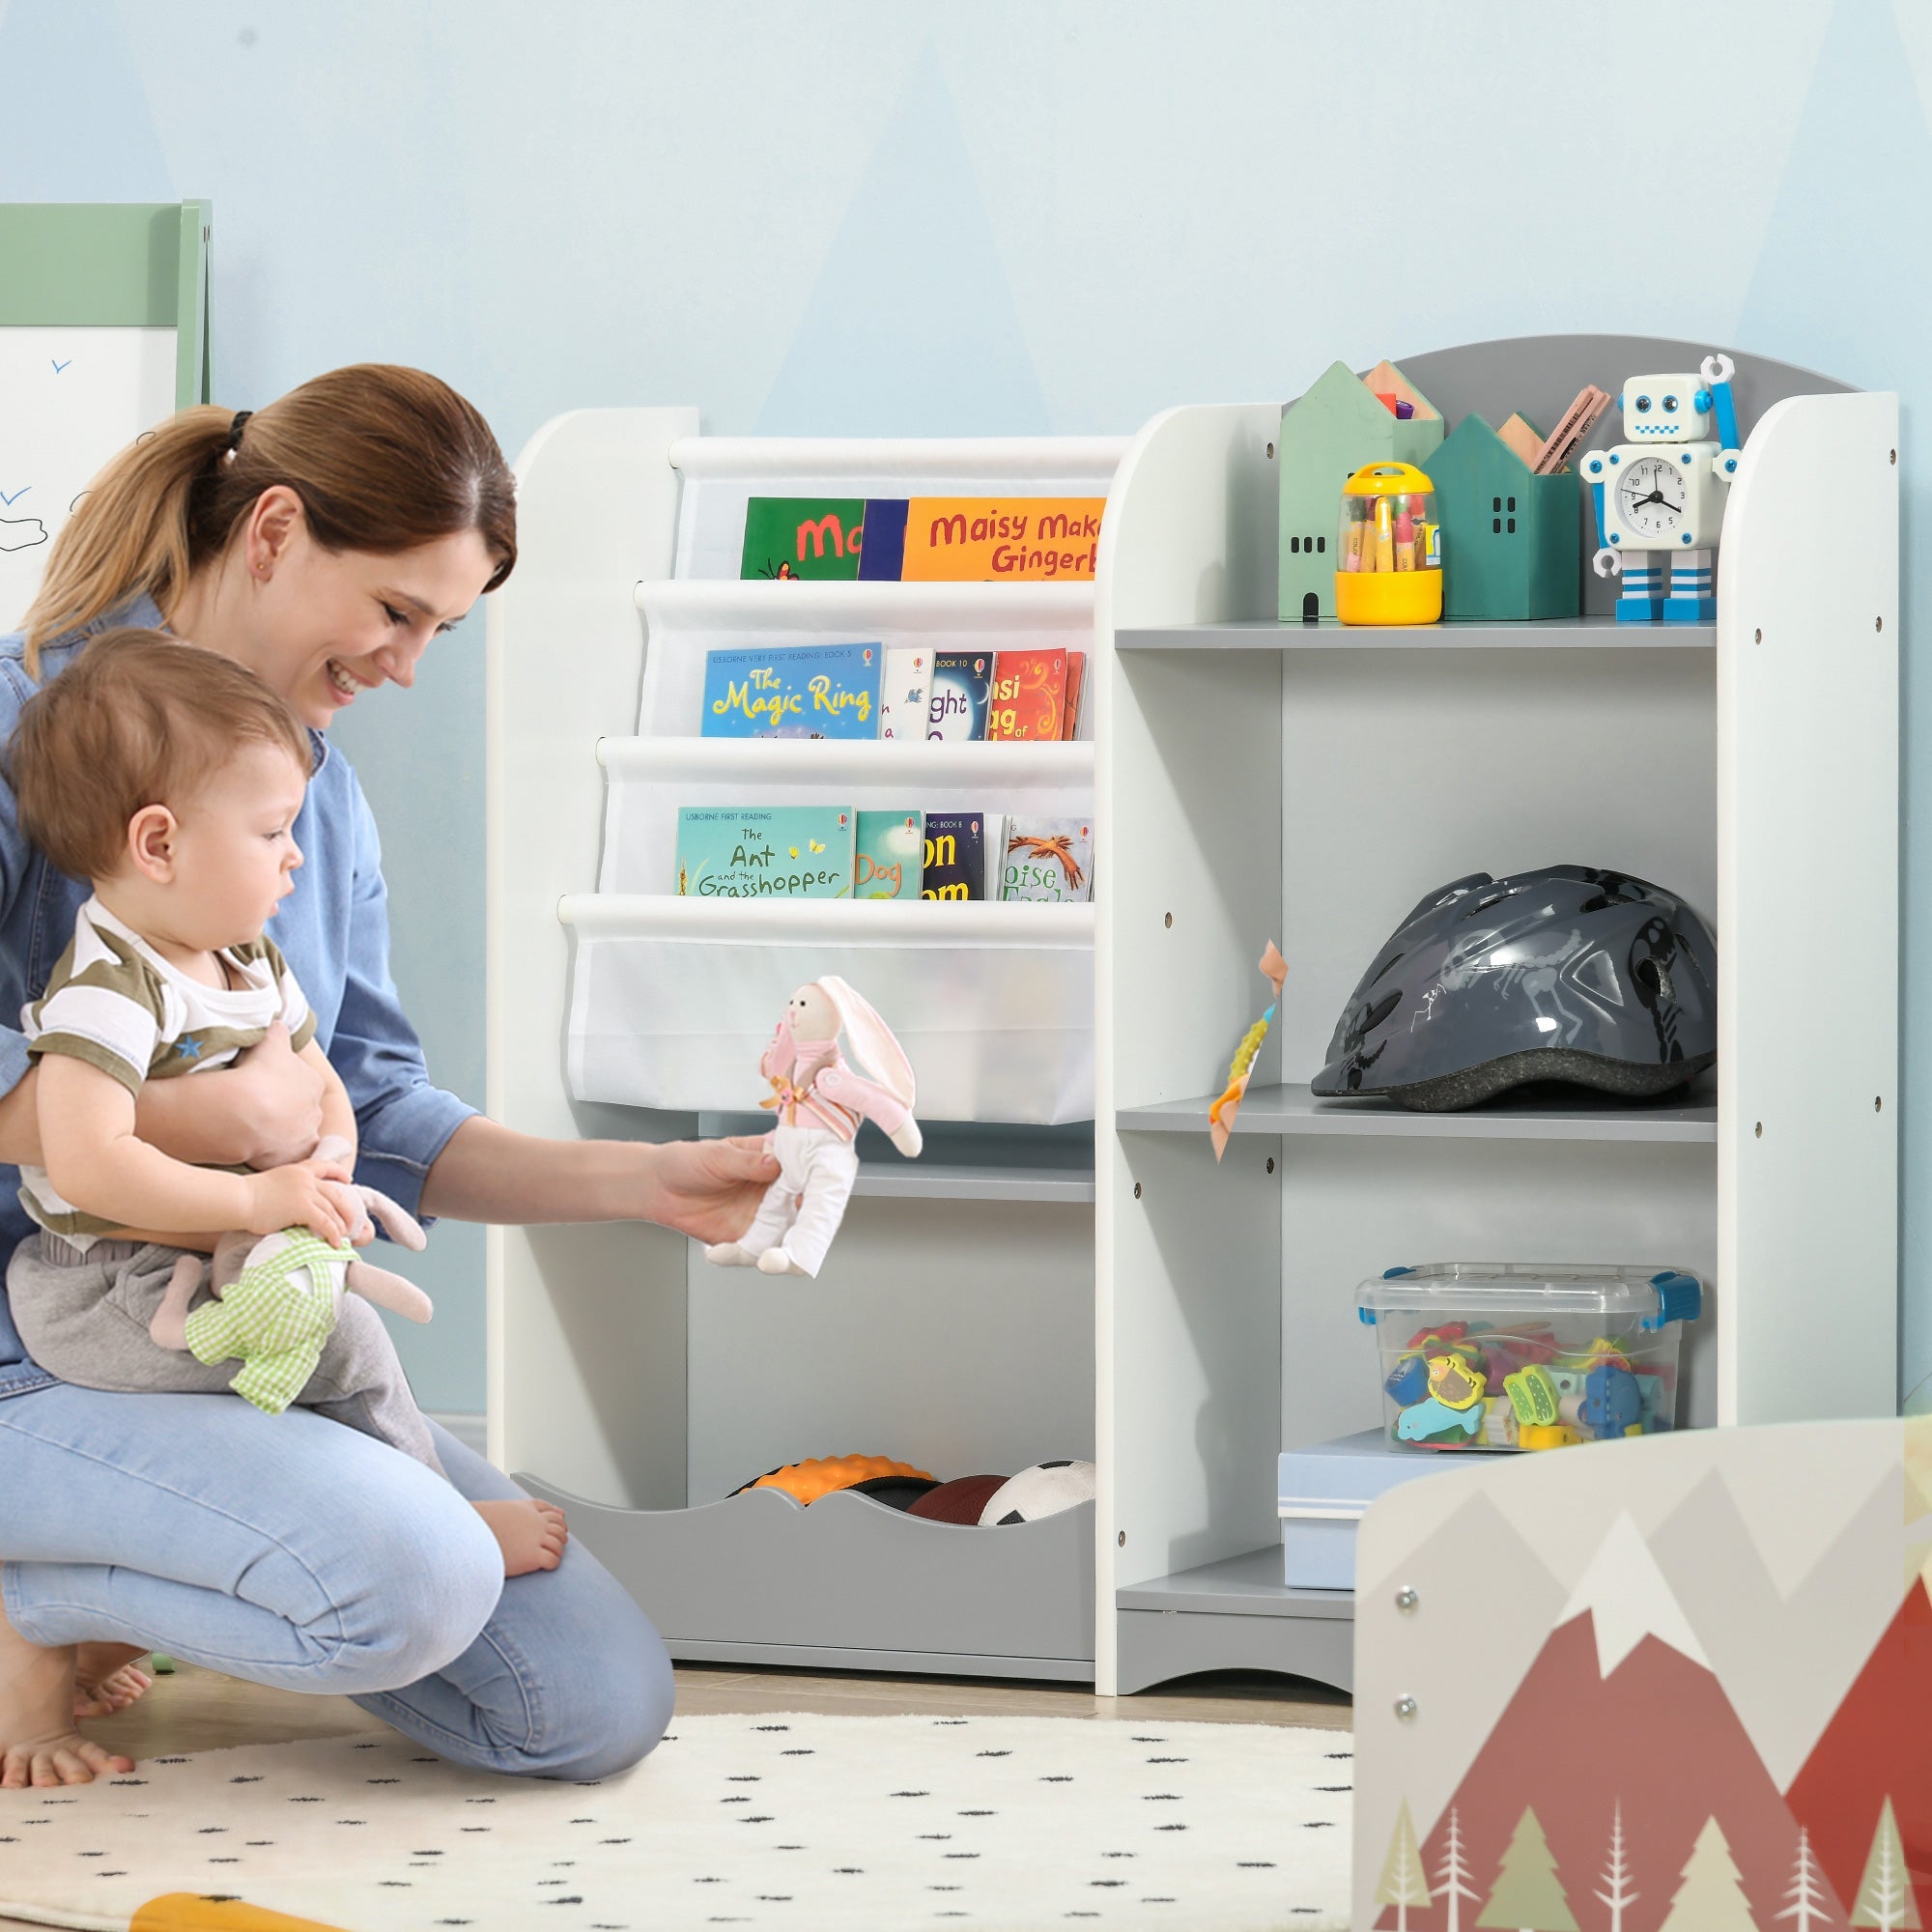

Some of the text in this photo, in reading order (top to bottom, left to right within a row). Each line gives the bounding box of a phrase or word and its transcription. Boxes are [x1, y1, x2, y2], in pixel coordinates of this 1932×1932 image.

[929, 509, 1101, 548] Maisy Mak
[750, 654, 767, 663] VERY
[768, 653, 786, 662] FIRST
[959, 659, 968, 668] 10
[750, 667, 781, 690] The
[712, 674, 871, 726] Magic Ring
[1014, 724, 1028, 738] of
[742, 829, 762, 840] The
[730, 844, 776, 867] Ant
[698, 870, 840, 898] Grasshopper
[718, 871, 754, 881] and the
[856, 854, 901, 896] Dog
